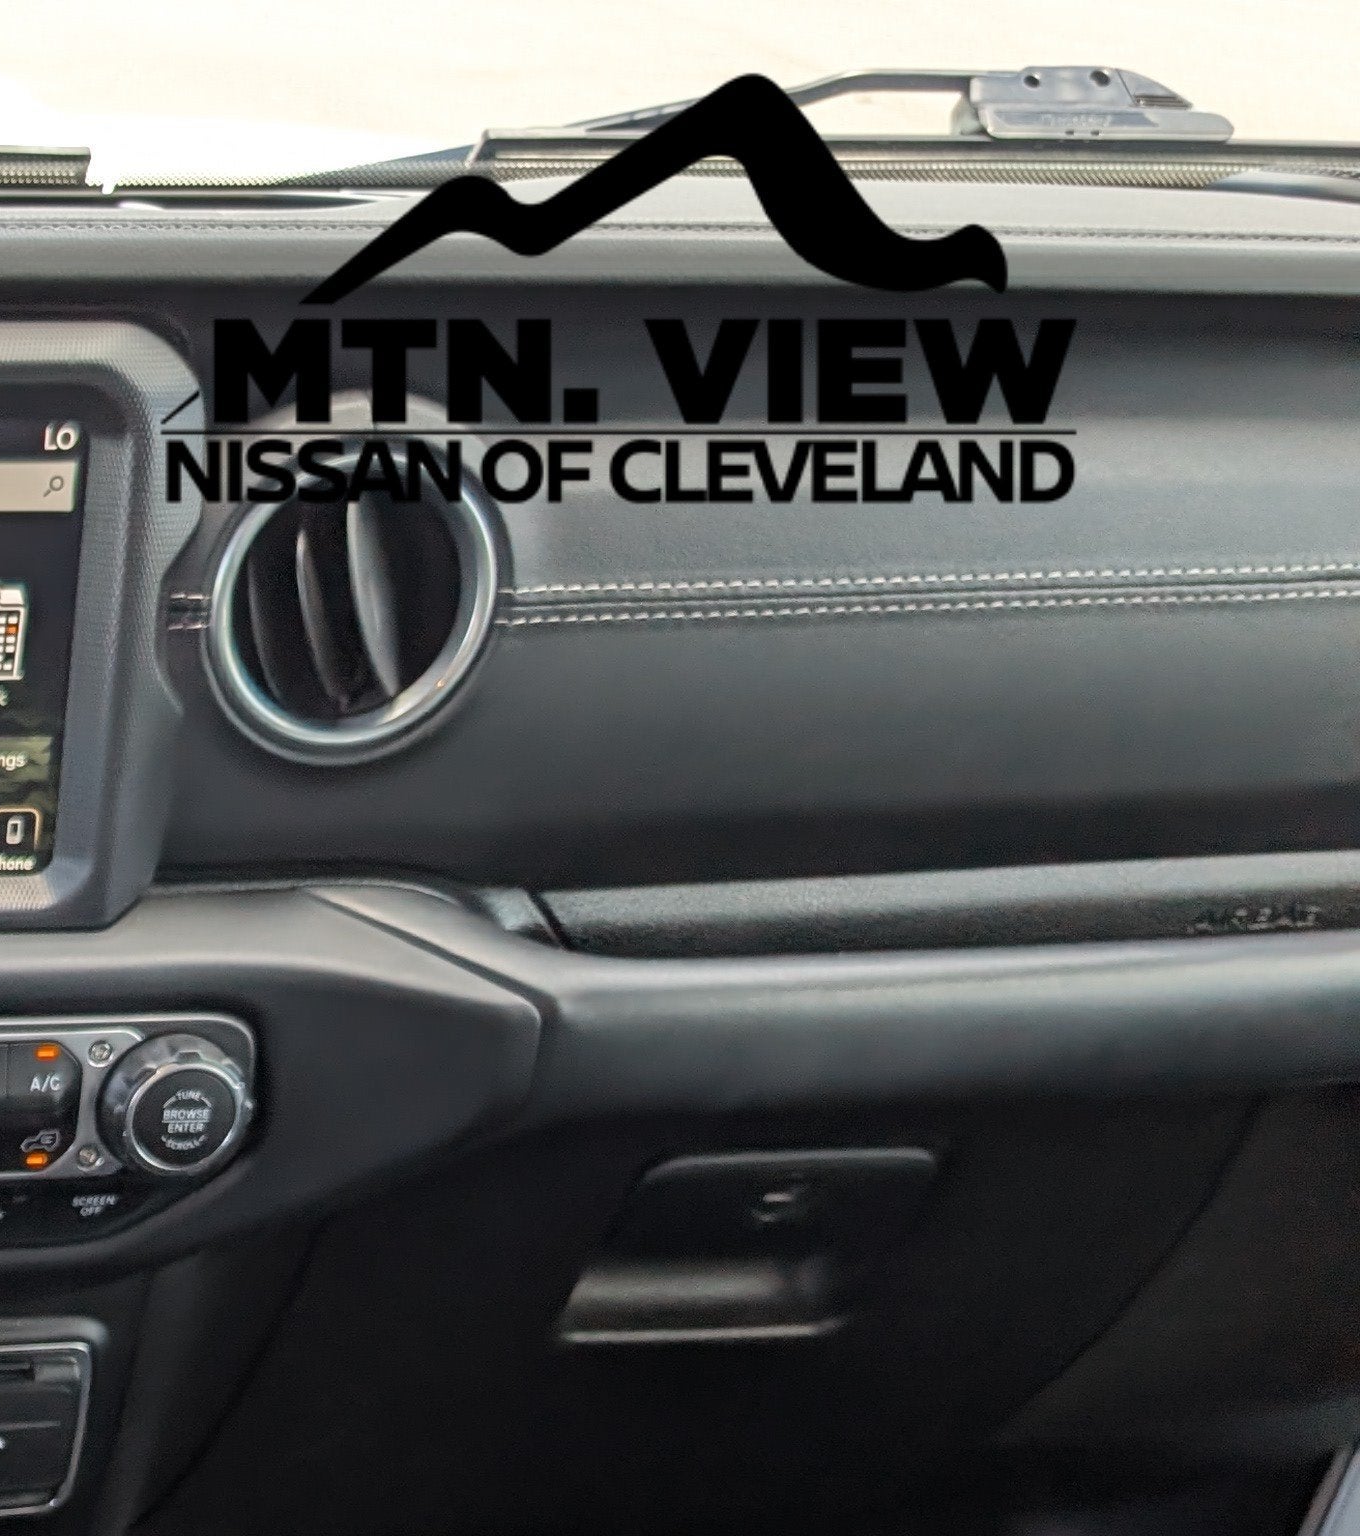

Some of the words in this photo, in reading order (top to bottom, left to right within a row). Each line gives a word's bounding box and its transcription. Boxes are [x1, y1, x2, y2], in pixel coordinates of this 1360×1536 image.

[44, 422, 78, 451] LO
[30, 1074, 61, 1092] A/C
[163, 1108, 209, 1121] BROWSE
[167, 1122, 203, 1134] ENTER
[80, 1206, 102, 1217] OFF
